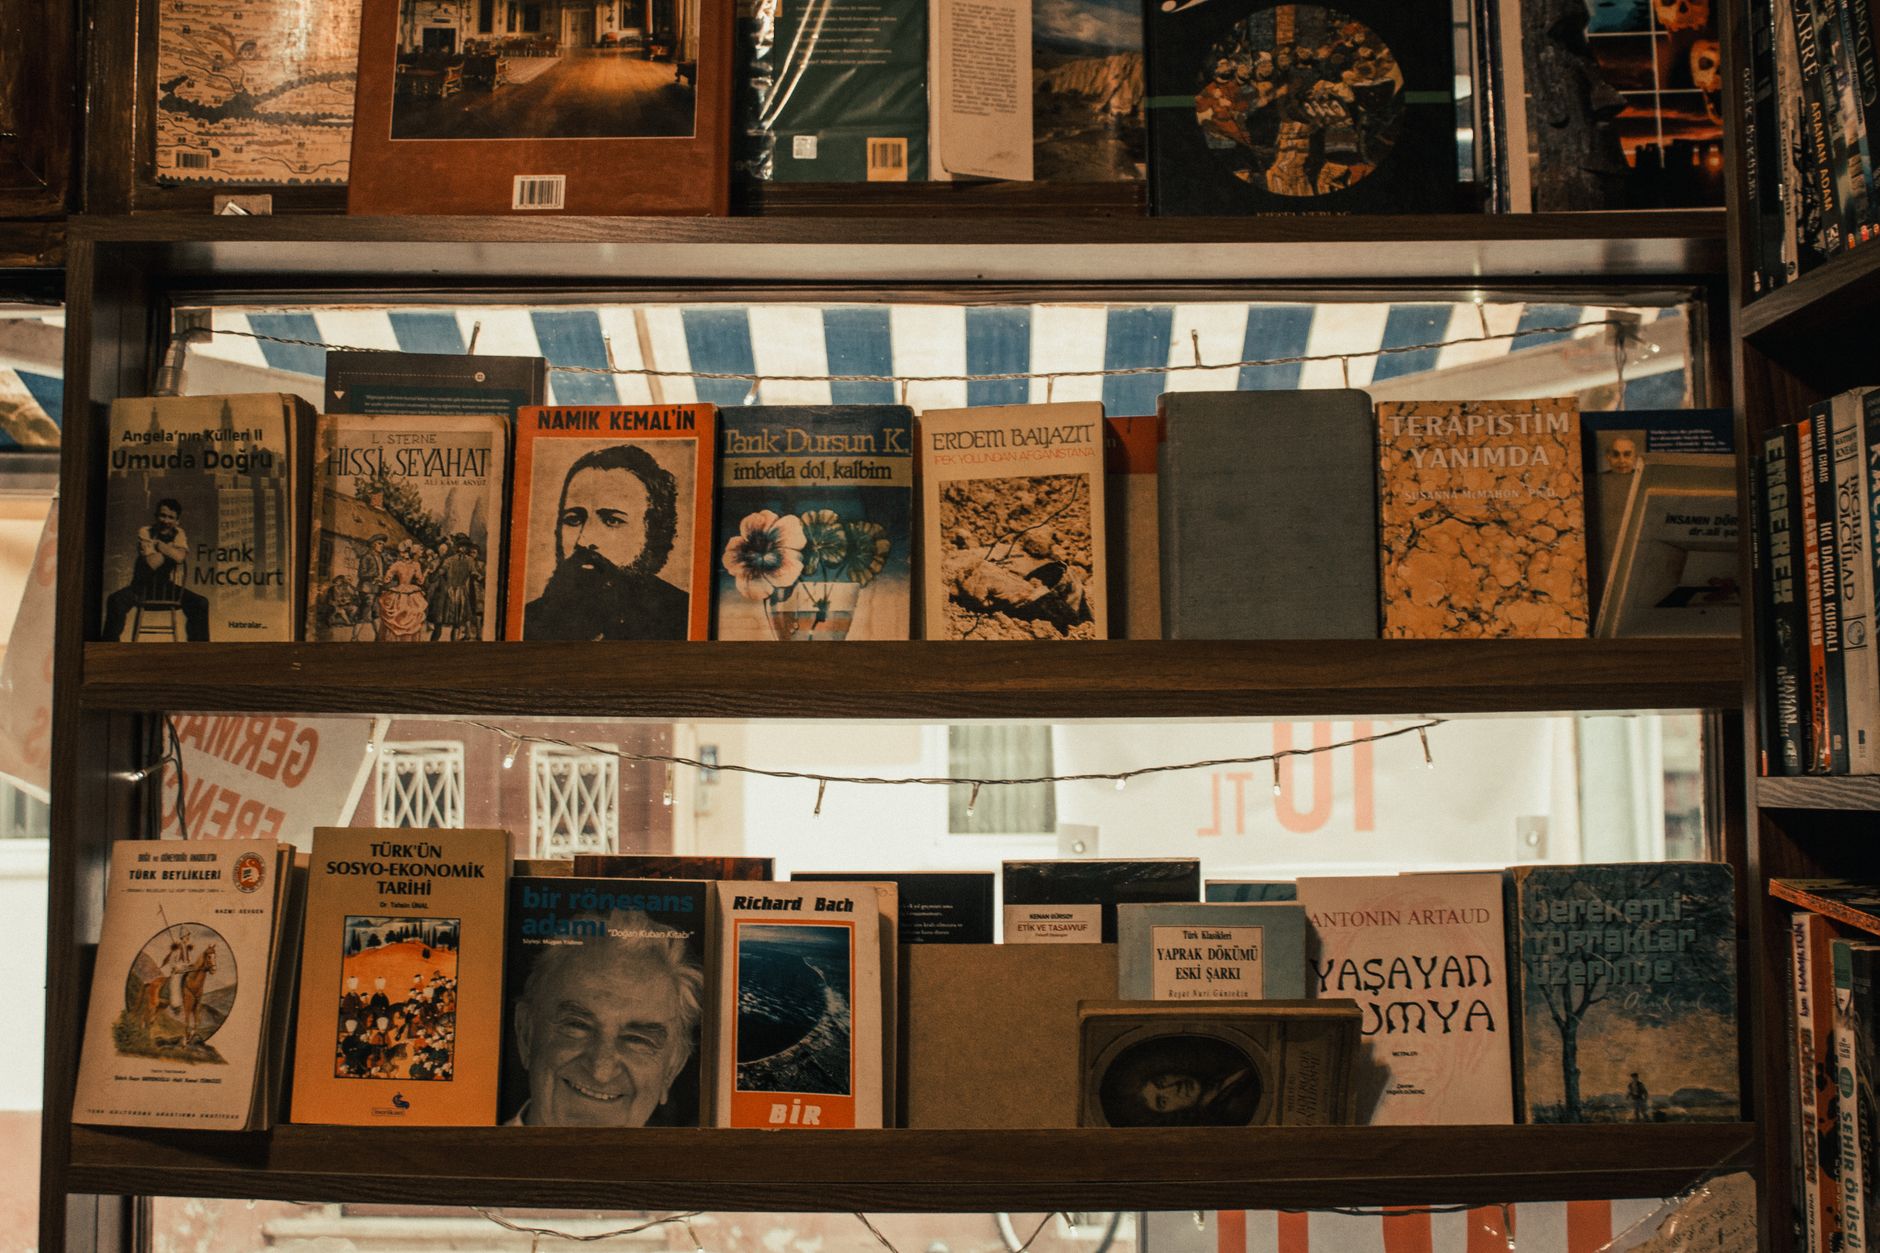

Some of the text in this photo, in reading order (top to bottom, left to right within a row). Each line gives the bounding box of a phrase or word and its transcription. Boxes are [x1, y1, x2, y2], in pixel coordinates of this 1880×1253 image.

[1811, 101, 1834, 211] ARANAN ADAM
[537, 405, 695, 430] NAMIK KEMAL'İN
[1387, 408, 1570, 437] TERAPİSTİM
[205, 429, 250, 442] Külleri
[387, 433, 438, 444] STERNE
[784, 427, 878, 453] Dursun
[931, 423, 1096, 451] ERDEM BAYAZIT
[111, 448, 273, 473] Umuda Doğru
[1409, 445, 1550, 469] YANIMDA
[1816, 414, 1829, 484] ROBERT CRAIS
[394, 447, 492, 477] SEYAHAT
[733, 460, 796, 480] imbatla
[832, 459, 892, 479] kalbim
[1713, 514, 1738, 527] DÖR
[197, 543, 255, 563] Frank
[193, 567, 284, 586] McCourt
[1821, 545, 1838, 598] DAKİKA
[1824, 602, 1838, 652] KURALI
[370, 841, 443, 859] TÜRK'ÜN
[129, 869, 222, 881] TÜRK BEYLİKLERİ
[326, 861, 485, 878] SOSYO-EKONOMİK
[376, 879, 432, 896] TARİHİ
[522, 885, 695, 913] bir rönesans
[732, 895, 855, 912] Richard Bach
[521, 912, 606, 937] adamı
[1037, 923, 1047, 932] VE
[1049, 924, 1088, 932] TASAVVUF
[1310, 908, 1491, 928] ANTONIN ARTAUD
[1183, 930, 1233, 940] Türk Klasikleri
[1156, 945, 1258, 961] YAPRAK DÖKÜMÜ
[1794, 923, 1807, 992] HAMILTON
[1175, 964, 1241, 982] ESKİ ŞARKI
[1309, 955, 1492, 996] YAŞAYAN
[1361, 1000, 1496, 1036] UMYA
[768, 1098, 822, 1125] BİR
